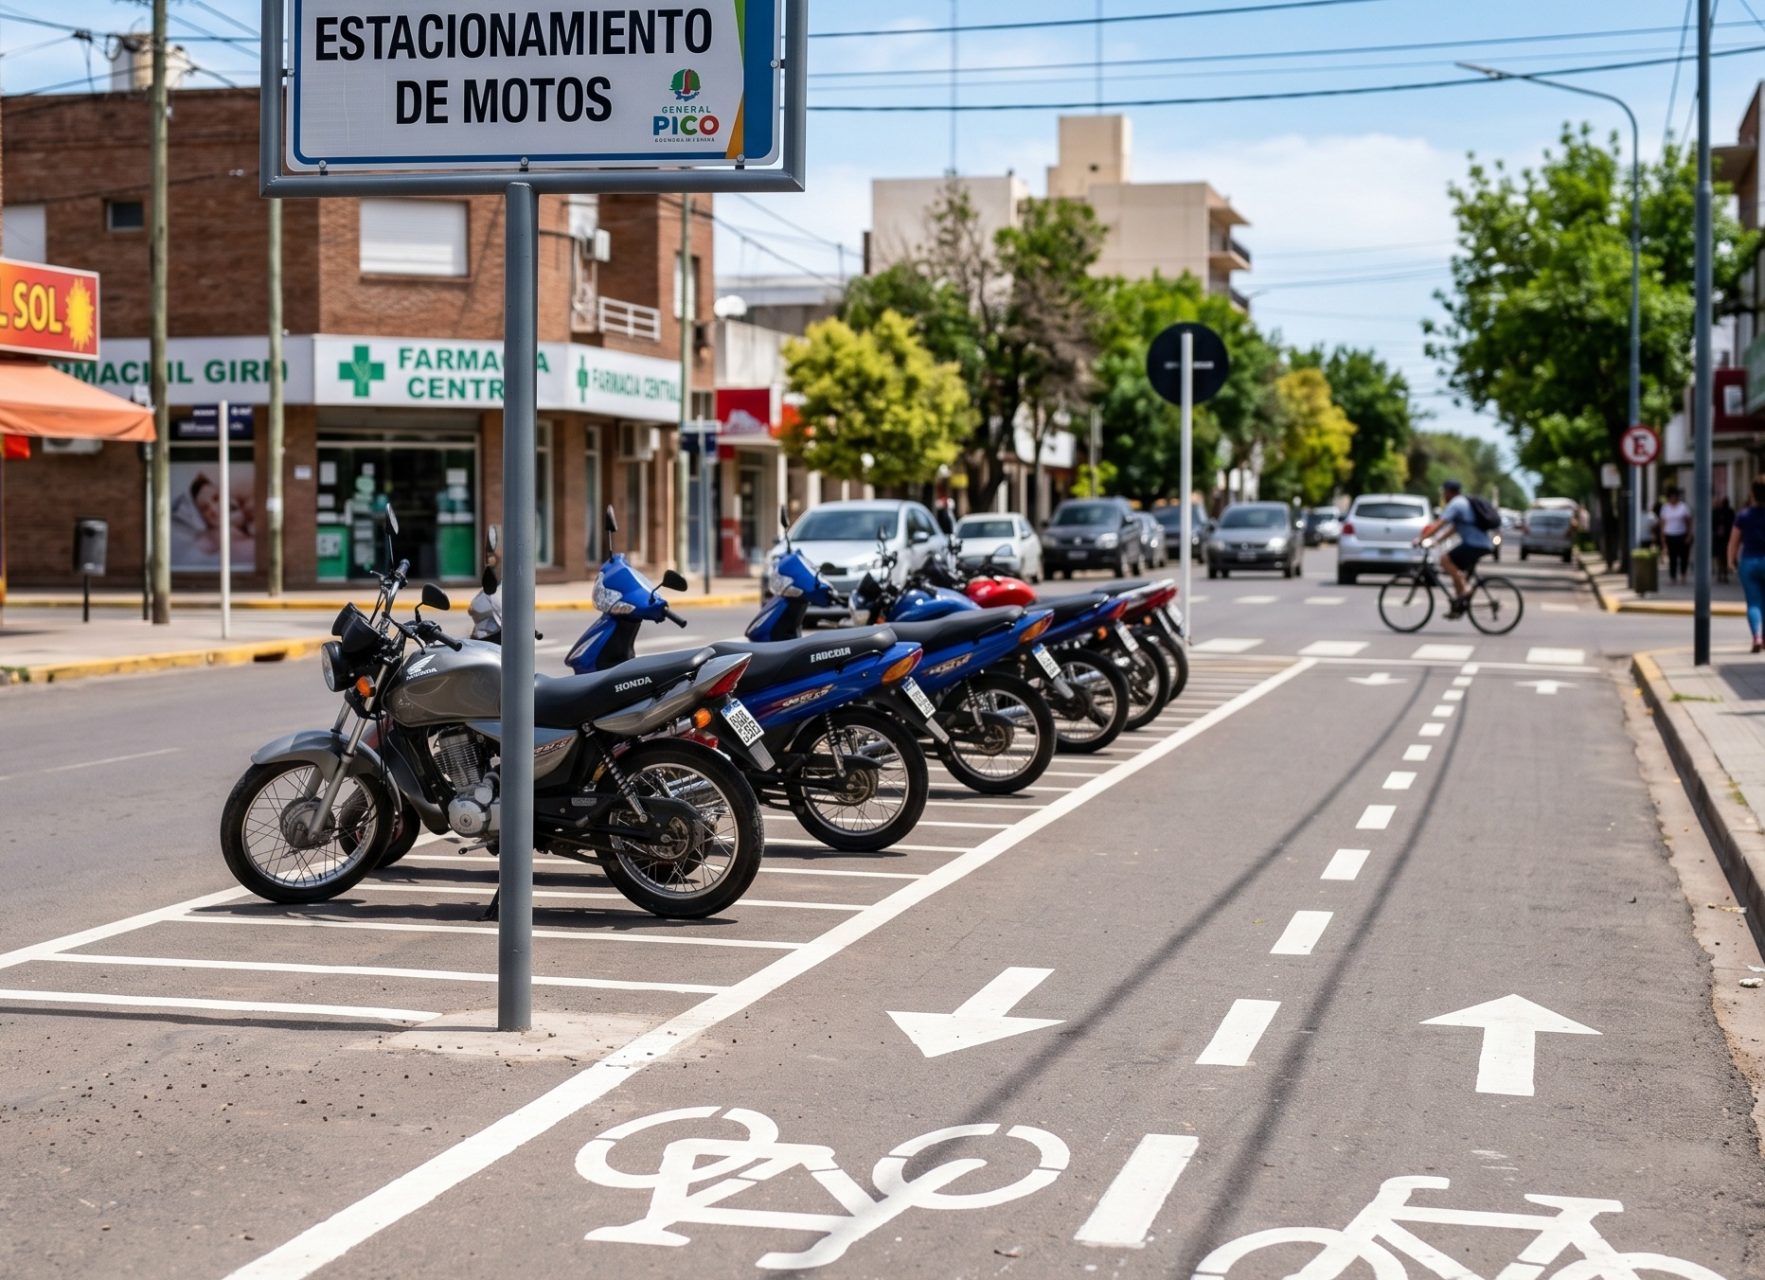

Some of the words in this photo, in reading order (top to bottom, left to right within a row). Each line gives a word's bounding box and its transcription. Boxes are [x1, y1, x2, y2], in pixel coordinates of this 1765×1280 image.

[315, 8, 713, 61] ESTACIONAMIENTO
[396, 79, 449, 125] DE
[463, 76, 613, 124] MOTOS
[661, 105, 712, 114] GENERAL
[652, 115, 720, 136] PICO
[13, 280, 63, 333] SOL
[407, 376, 505, 400] CENTR
[614, 676, 653, 693] HONDA
